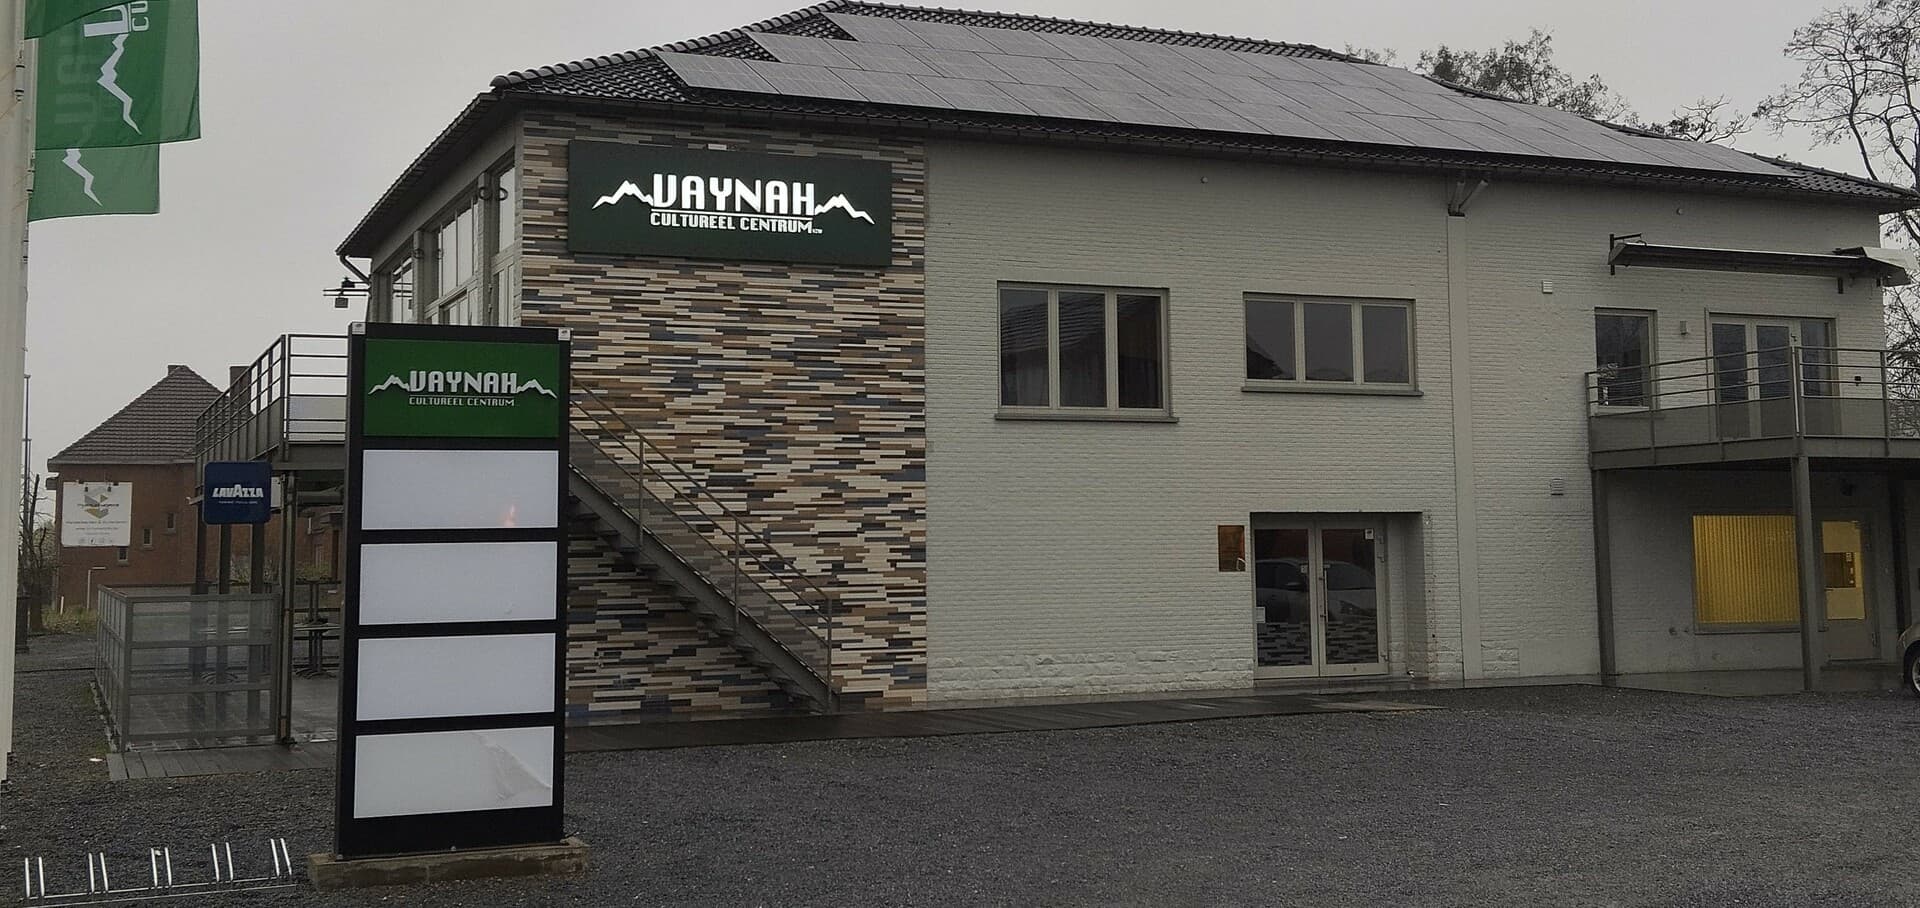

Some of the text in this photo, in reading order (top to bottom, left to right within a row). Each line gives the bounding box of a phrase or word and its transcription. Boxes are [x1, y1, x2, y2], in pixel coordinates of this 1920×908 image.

[652, 173, 815, 216] VAYNAH
[650, 213, 812, 234] CULTUREEL CENTRUM
[409, 370, 517, 394] VAYNAH
[409, 396, 515, 407] CULTUREEL CENTRUM
[212, 484, 264, 498] LAVAZZA
